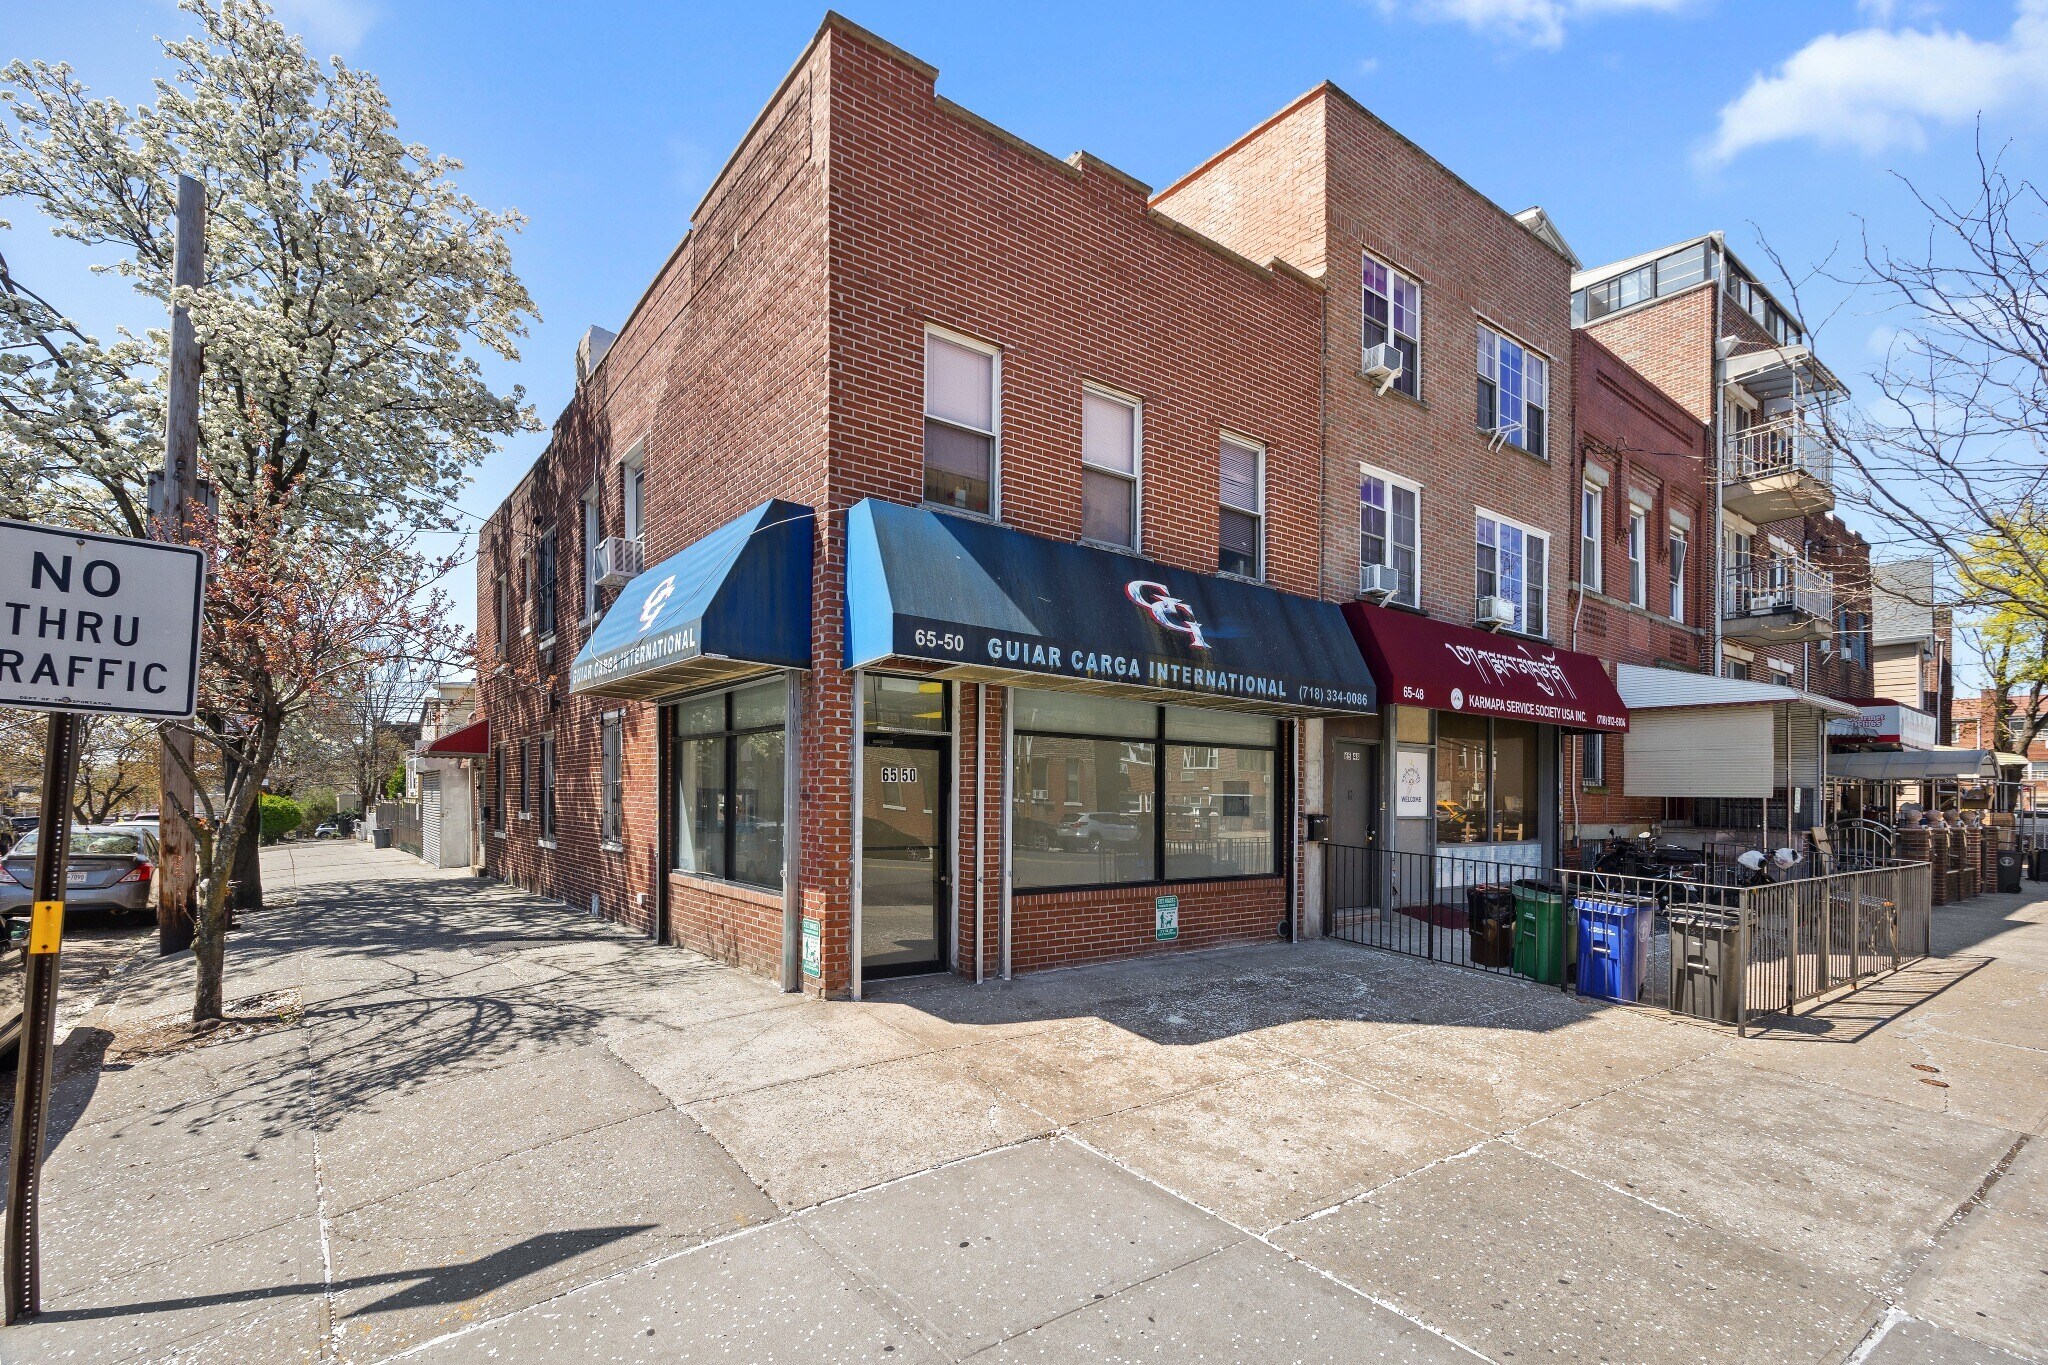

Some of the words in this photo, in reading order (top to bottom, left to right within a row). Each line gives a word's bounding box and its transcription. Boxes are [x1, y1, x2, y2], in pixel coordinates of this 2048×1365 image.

[31, 551, 121, 597] NO
[5, 601, 140, 647] THRU
[914, 629, 964, 652] 65-50
[594, 655, 618, 678] CARGA
[620, 627, 696, 670] INTERNATIONAL
[987, 638, 1062, 669] GUIAR
[1071, 650, 1141, 678] CARGA
[1149, 661, 1287, 697] INTERNATIONAL
[1299, 685, 1324, 701] (718)
[1326, 688, 1368, 706] 334-0086
[1403, 686, 1424, 700] 65-48
[1469, 694, 1506, 711] KARMAPA
[1506, 700, 1535, 716] SERVICE
[1535, 704, 1561, 719] SOCIETY
[1561, 708, 1575, 720] USA
[1575, 710, 1588, 723] INC.
[882, 768, 897, 782] 65
[902, 768, 916, 782] 50
